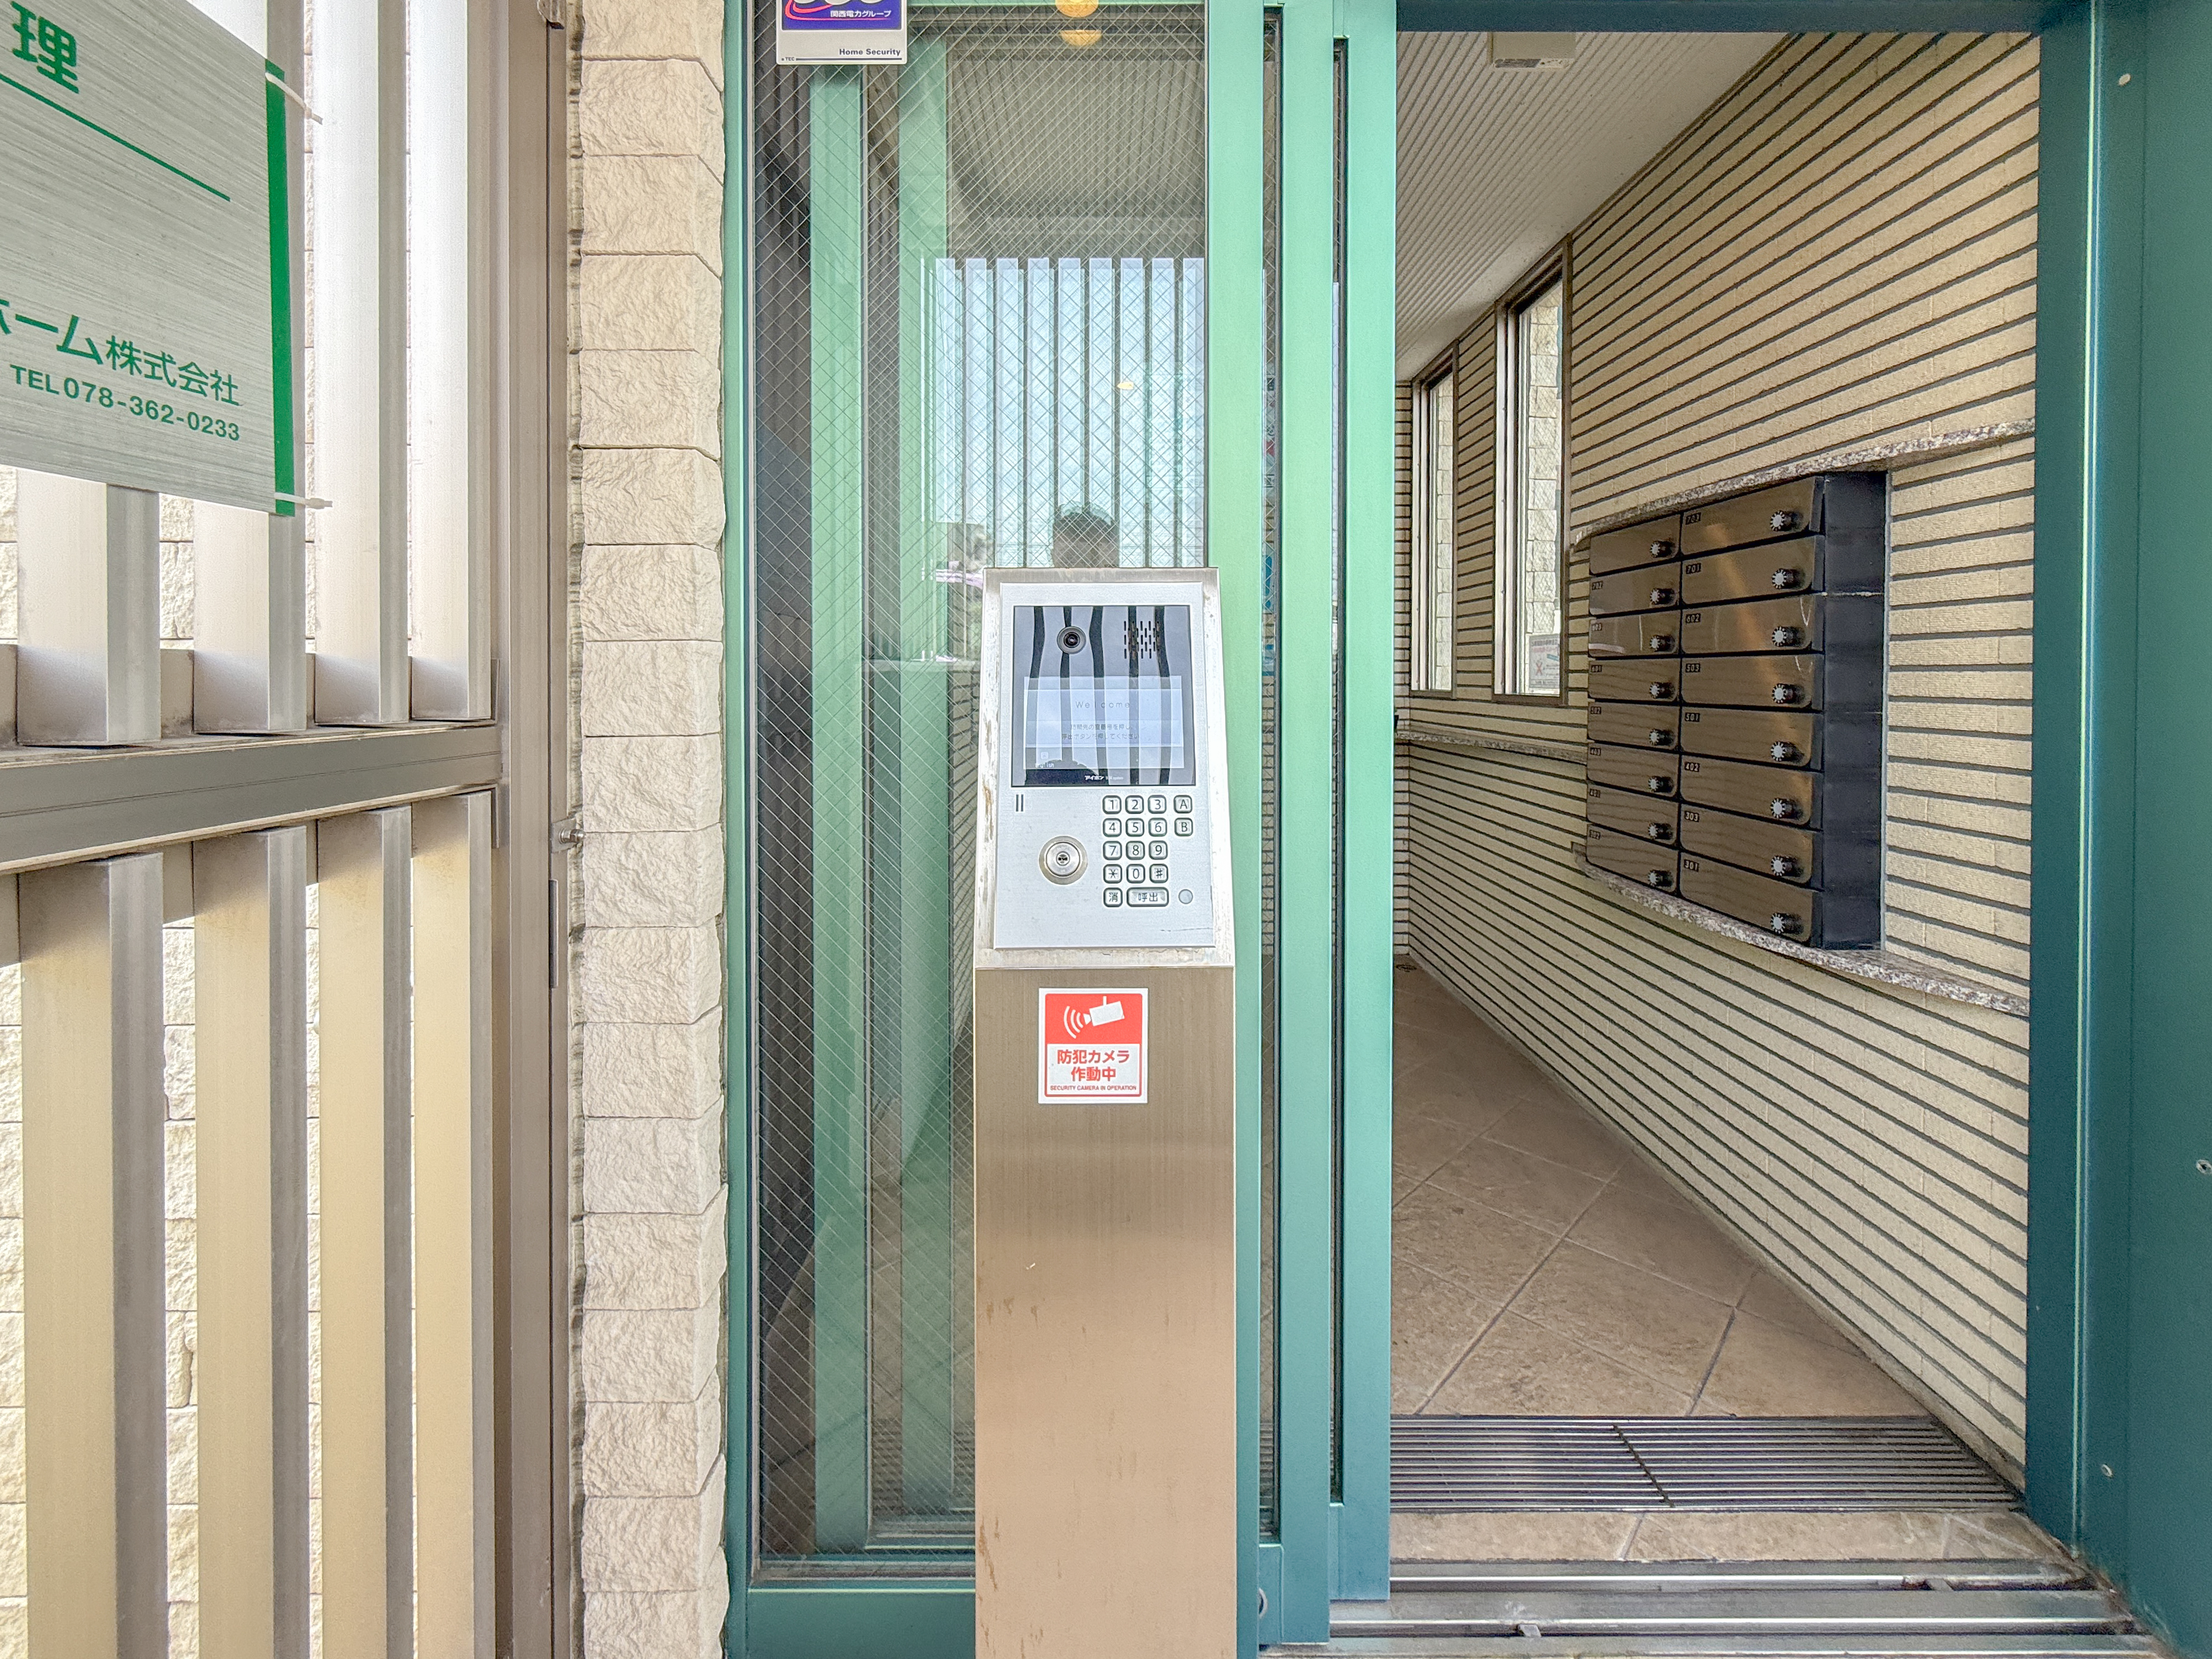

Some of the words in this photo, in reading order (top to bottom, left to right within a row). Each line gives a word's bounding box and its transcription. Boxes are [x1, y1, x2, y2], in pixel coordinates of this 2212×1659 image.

[830, 10, 892, 18] 関西電力グループ
[10, 1, 80, 94] 理
[866, 48, 901, 57] Security
[1075, 701, 1130, 709] Welcome
[1685, 713, 1699, 721] 501
[1685, 763, 1699, 771] 402
[1110, 799, 1114, 810] 1
[1131, 799, 1139, 810] 2
[1154, 799, 1161, 810] 3
[1180, 799, 1188, 809] A
[1685, 811, 1699, 821] 303
[1109, 822, 1116, 833] 4
[1132, 822, 1139, 833] 5
[1155, 822, 1162, 833] 6
[1181, 822, 1188, 832] B
[1108, 845, 1117, 856] 7
[1132, 844, 1139, 856] 8
[1155, 845, 1162, 856] 9
[1684, 861, 1698, 871] 301
[1132, 868, 1139, 879] 0
[1155, 868, 1163, 879] #
[1109, 891, 1118, 902] 消
[1138, 892, 1158, 902] 呼出
[1057, 1049, 1130, 1064] 防犯カメラ
[1071, 1066, 1116, 1082] 作動中
